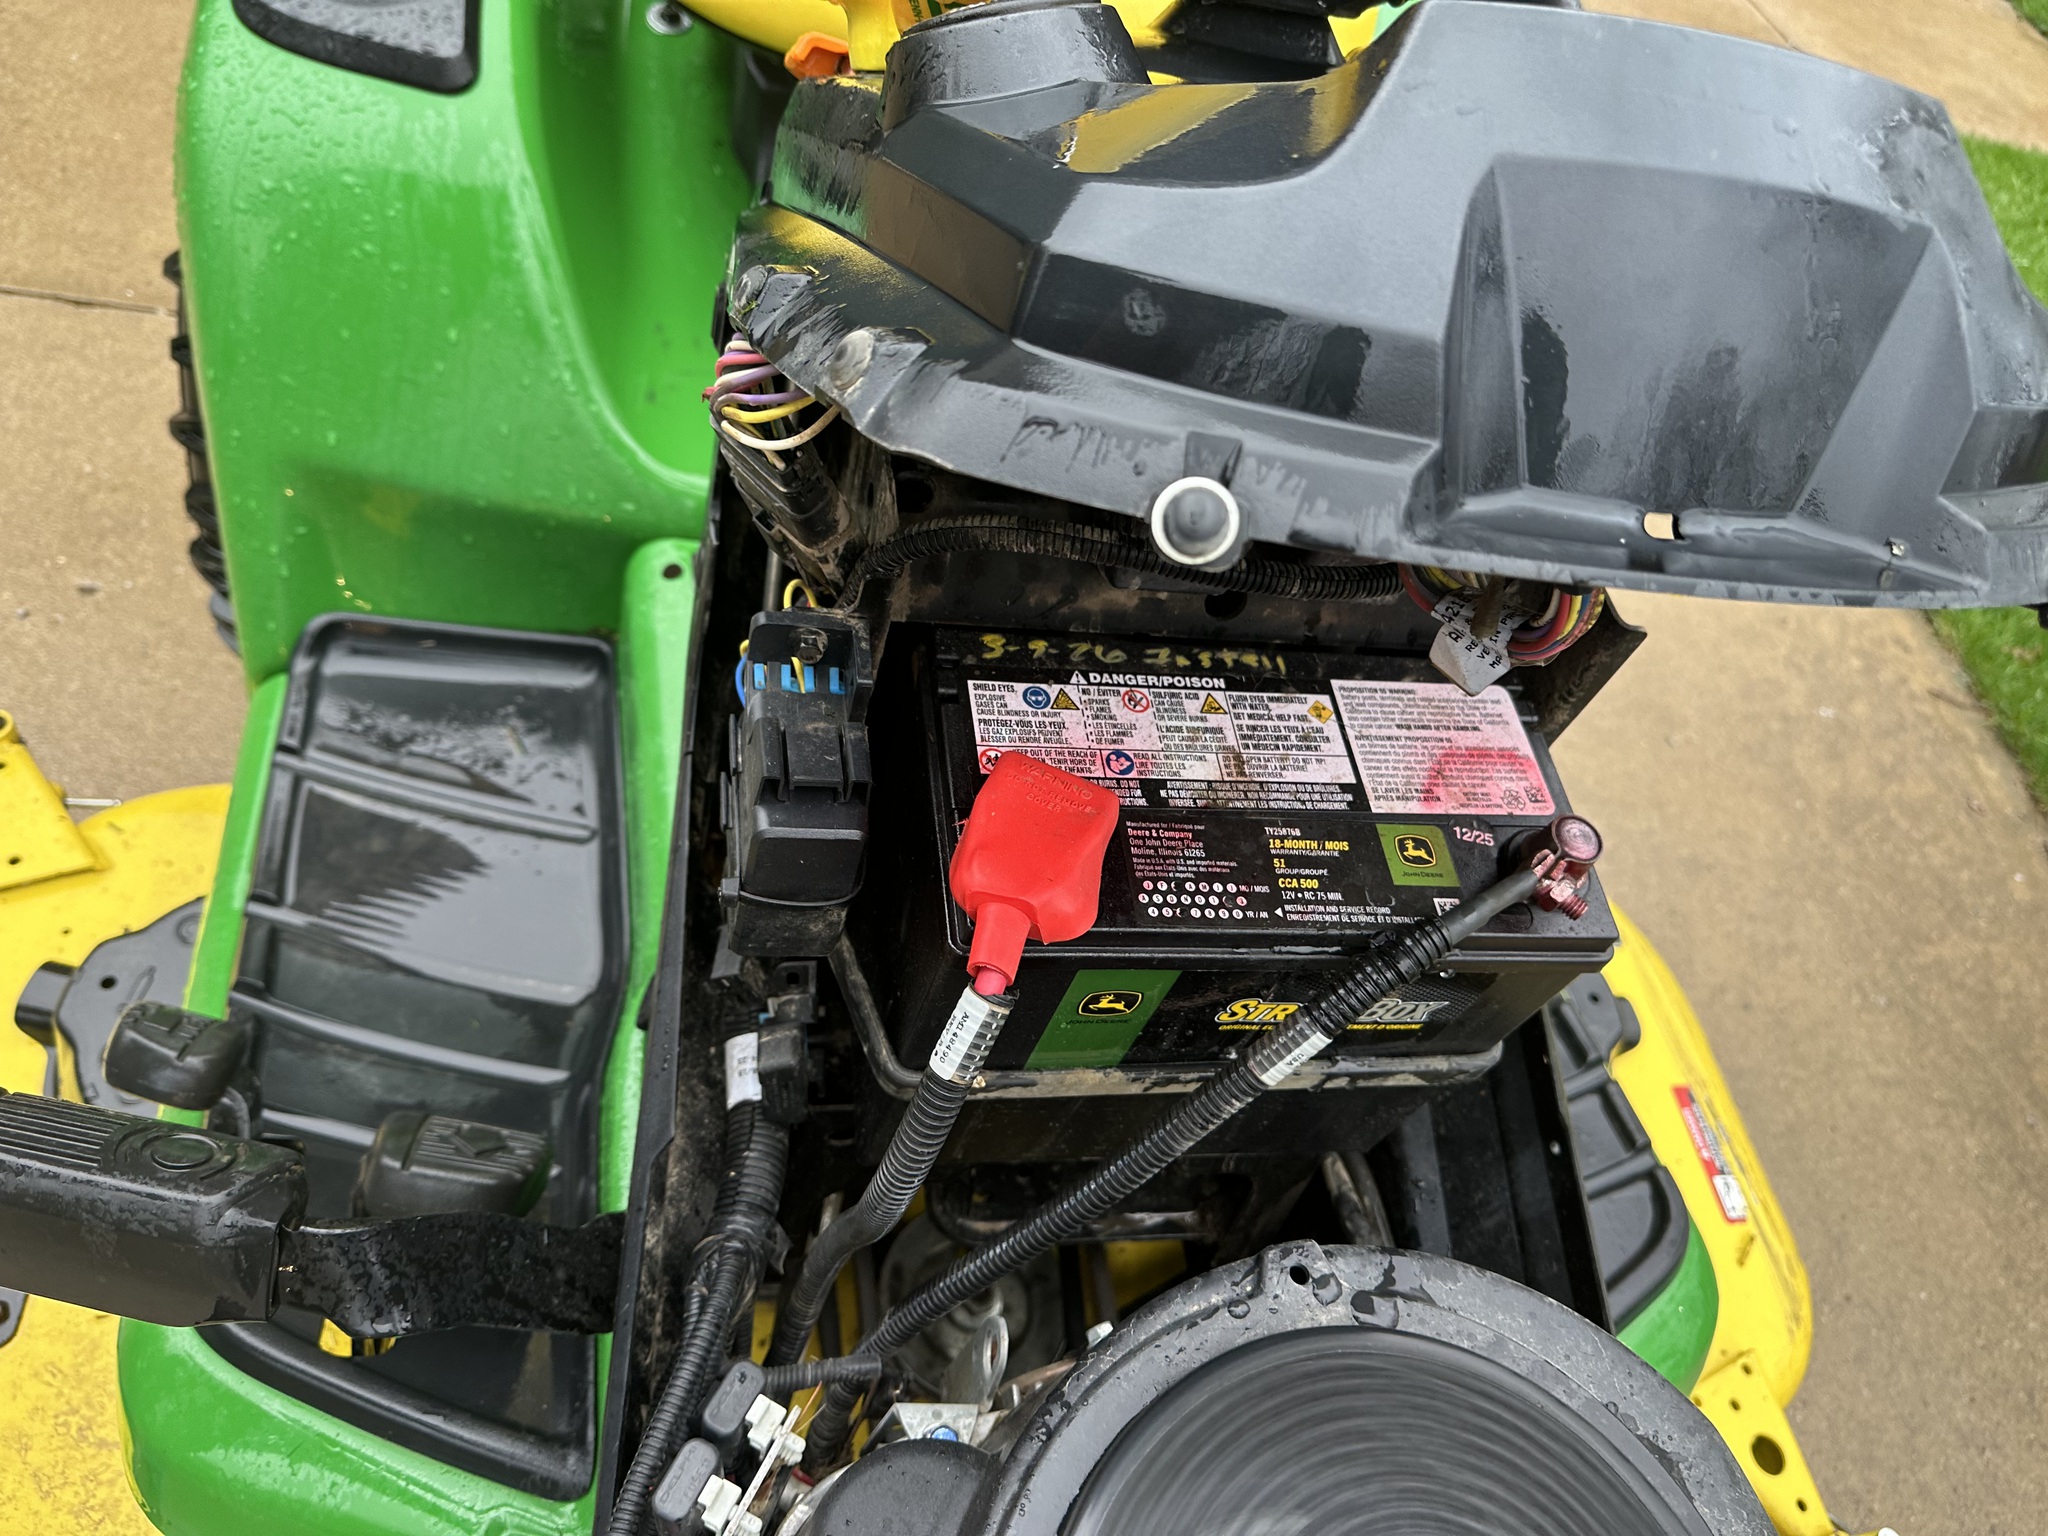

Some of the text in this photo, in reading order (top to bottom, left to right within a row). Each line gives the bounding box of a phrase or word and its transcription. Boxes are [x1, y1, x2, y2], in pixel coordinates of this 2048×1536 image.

[1088, 672, 1226, 689] DANGER/POISON
[973, 682, 996, 692] SHIELD
[1152, 691, 1182, 699] SULFURIC
[1228, 694, 1248, 702] FLUSH
[1266, 696, 1308, 704] IMMEDIATELY
[1234, 712, 1245, 720] GET
[1247, 713, 1275, 721] MEDICAL
[978, 717, 1034, 728] PROTÉGEZ-VOUS
[1245, 725, 1269, 733] RINCER
[1295, 735, 1330, 743] CONSULTER
[1020, 762, 1093, 800] WARNING
[1024, 781, 1044, 793] NOT
[1048, 791, 1092, 813] REMOVE
[1168, 790, 1179, 798] PAS
[1026, 793, 1062, 812] COVER
[1128, 828, 1150, 836] Deere
[1159, 829, 1192, 839] Company
[1453, 826, 1494, 847] 12/25
[1146, 838, 1161, 846] John
[1162, 839, 1182, 847] Deere
[1184, 840, 1204, 848] Place
[1269, 839, 1349, 851] 18-MONTH / MOIS
[1130, 847, 1206, 857] Moline, Illinois 61265
[1270, 849, 1340, 857] WARRANTY/GARANTIE
[1273, 858, 1286, 868] 51
[1278, 878, 1319, 889] CCA 500
[1281, 890, 1326, 900] 12V RC 75
[1284, 904, 1325, 912] INSTALLATION
[1286, 914, 1340, 922] ENREGISTREMENT
[1351, 915, 1376, 923] SERVICE
[940, 1012, 969, 1064] AM148490
[1286, 1054, 1305, 1066] USA
